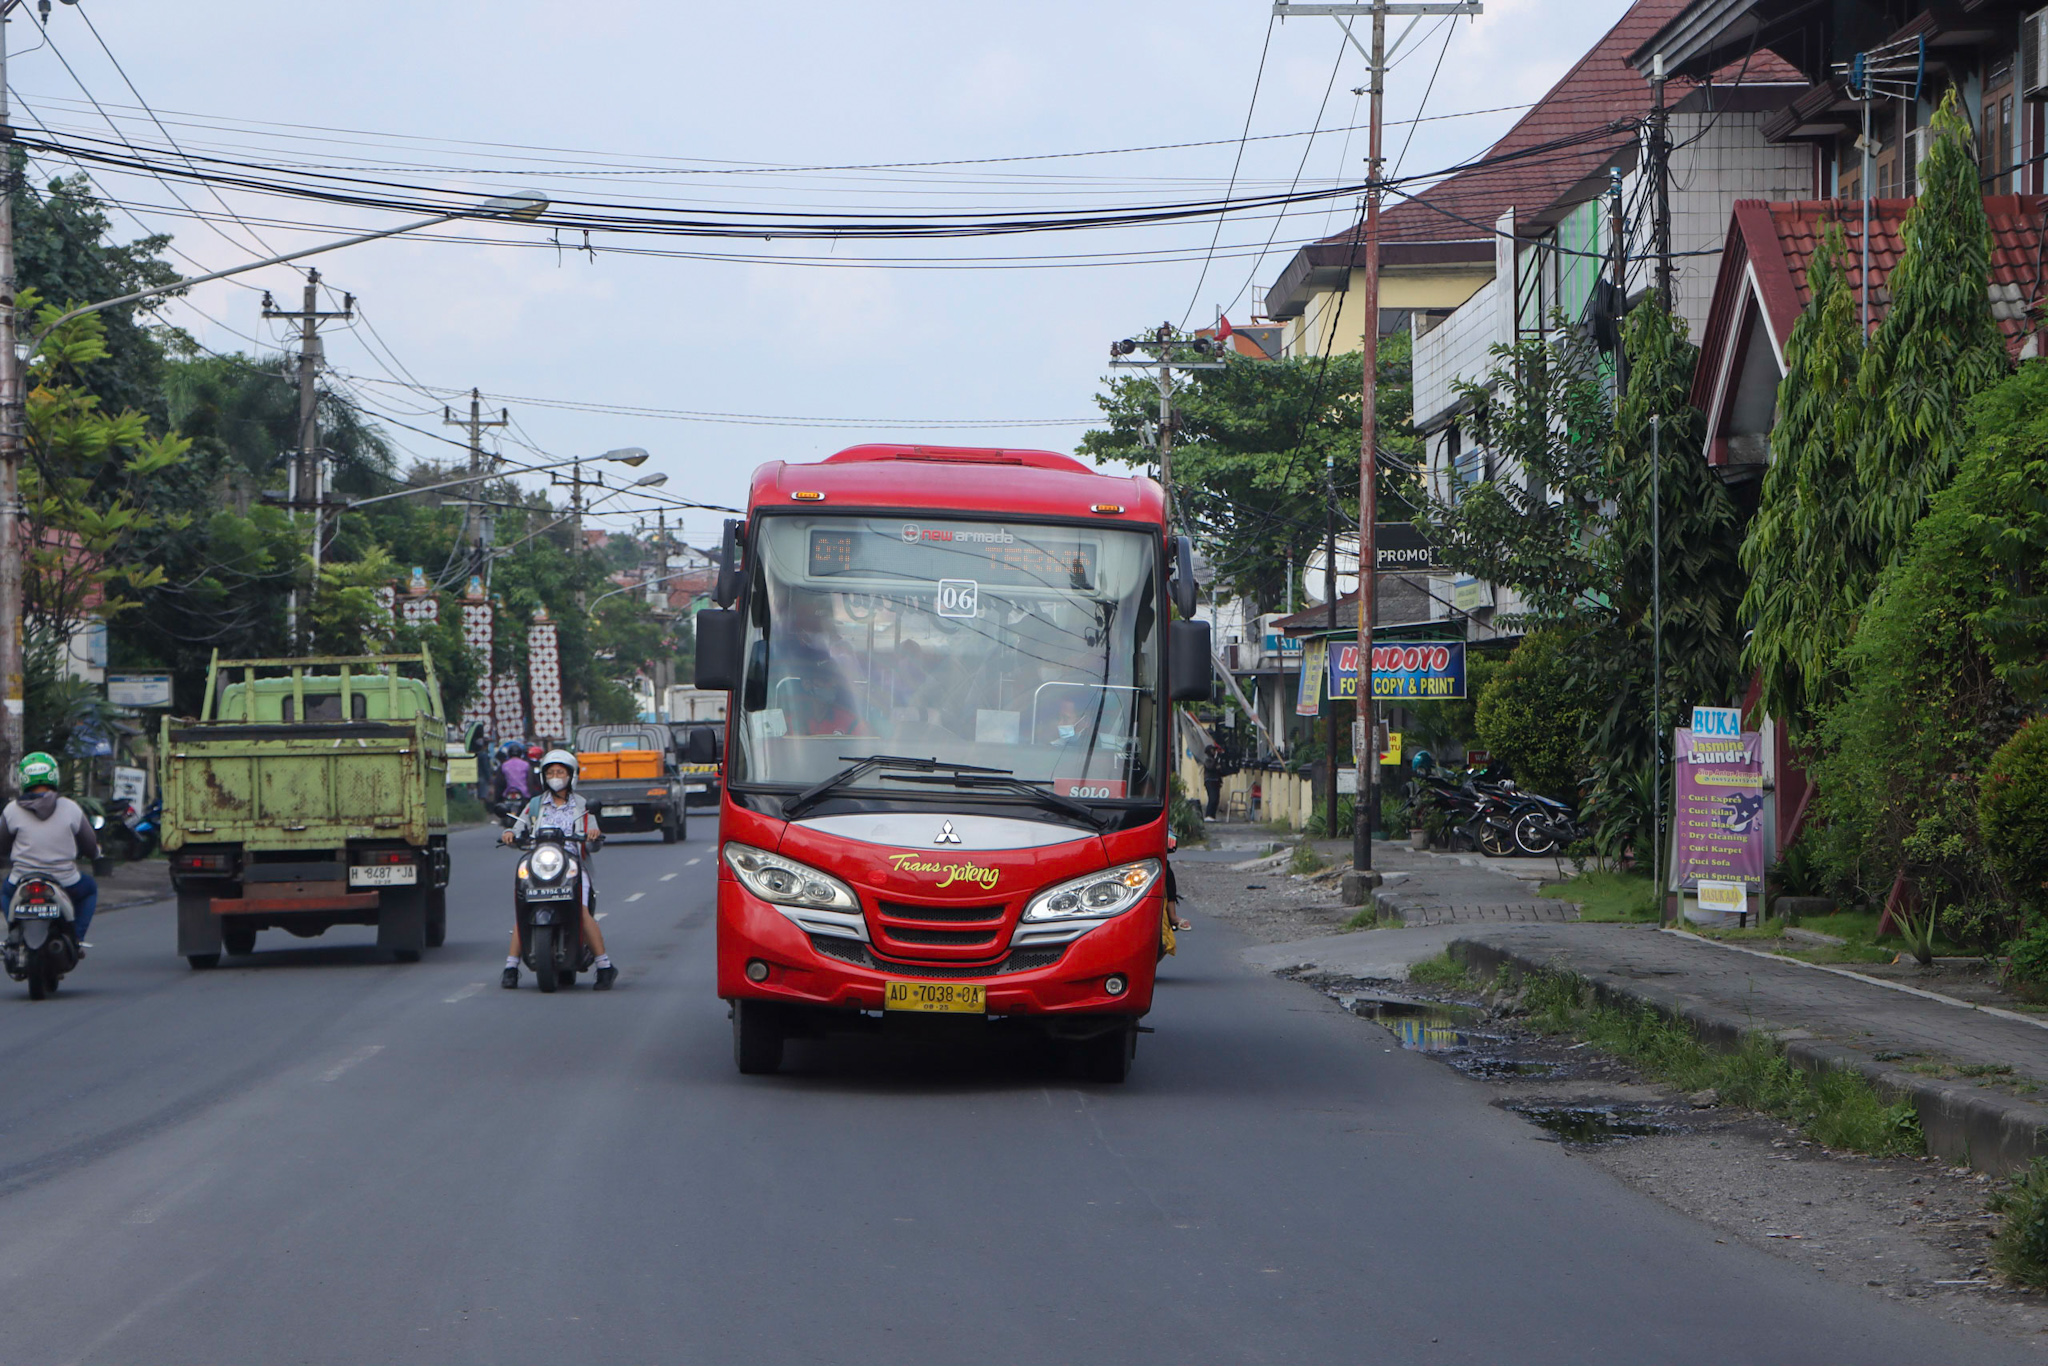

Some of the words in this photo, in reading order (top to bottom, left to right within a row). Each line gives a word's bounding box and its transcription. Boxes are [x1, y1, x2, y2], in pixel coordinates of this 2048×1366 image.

[921, 529, 953, 542] new
[955, 528, 1014, 545] armada
[1378, 549, 1428, 562] PROMO
[942, 586, 975, 610] 06
[1339, 646, 1450, 672] HNDOYO
[1373, 677, 1405, 694] COPY
[1408, 677, 1417, 694] &
[1420, 677, 1455, 694] PRINT
[1693, 710, 1740, 736] BUKA
[1687, 749, 1753, 765] Laundry
[1068, 786, 1110, 799] SOLO
[1688, 794, 1708, 802] Cuci
[1711, 795, 1742, 805] Expres
[1688, 807, 1708, 815] Cuci
[1711, 808, 1734, 816] Kilat
[1688, 820, 1708, 828] Cuci
[1689, 832, 1706, 840] Dry
[1708, 833, 1748, 843] Cleaning
[1711, 846, 1742, 855] Karpet
[1689, 858, 1709, 866] Cuci
[1711, 859, 1731, 867] Sofa
[351, 868, 359, 880] H
[366, 867, 392, 879] 8487
[888, 853, 942, 872] Trans
[935, 861, 1000, 890] Jateng
[1711, 873, 1742, 882] Spring
[1743, 875, 1761, 883] Bed
[1700, 888, 1725, 902] MASUK
[1726, 888, 1740, 902] AJA
[889, 984, 908, 1001] AD
[918, 985, 955, 1002] 7038
